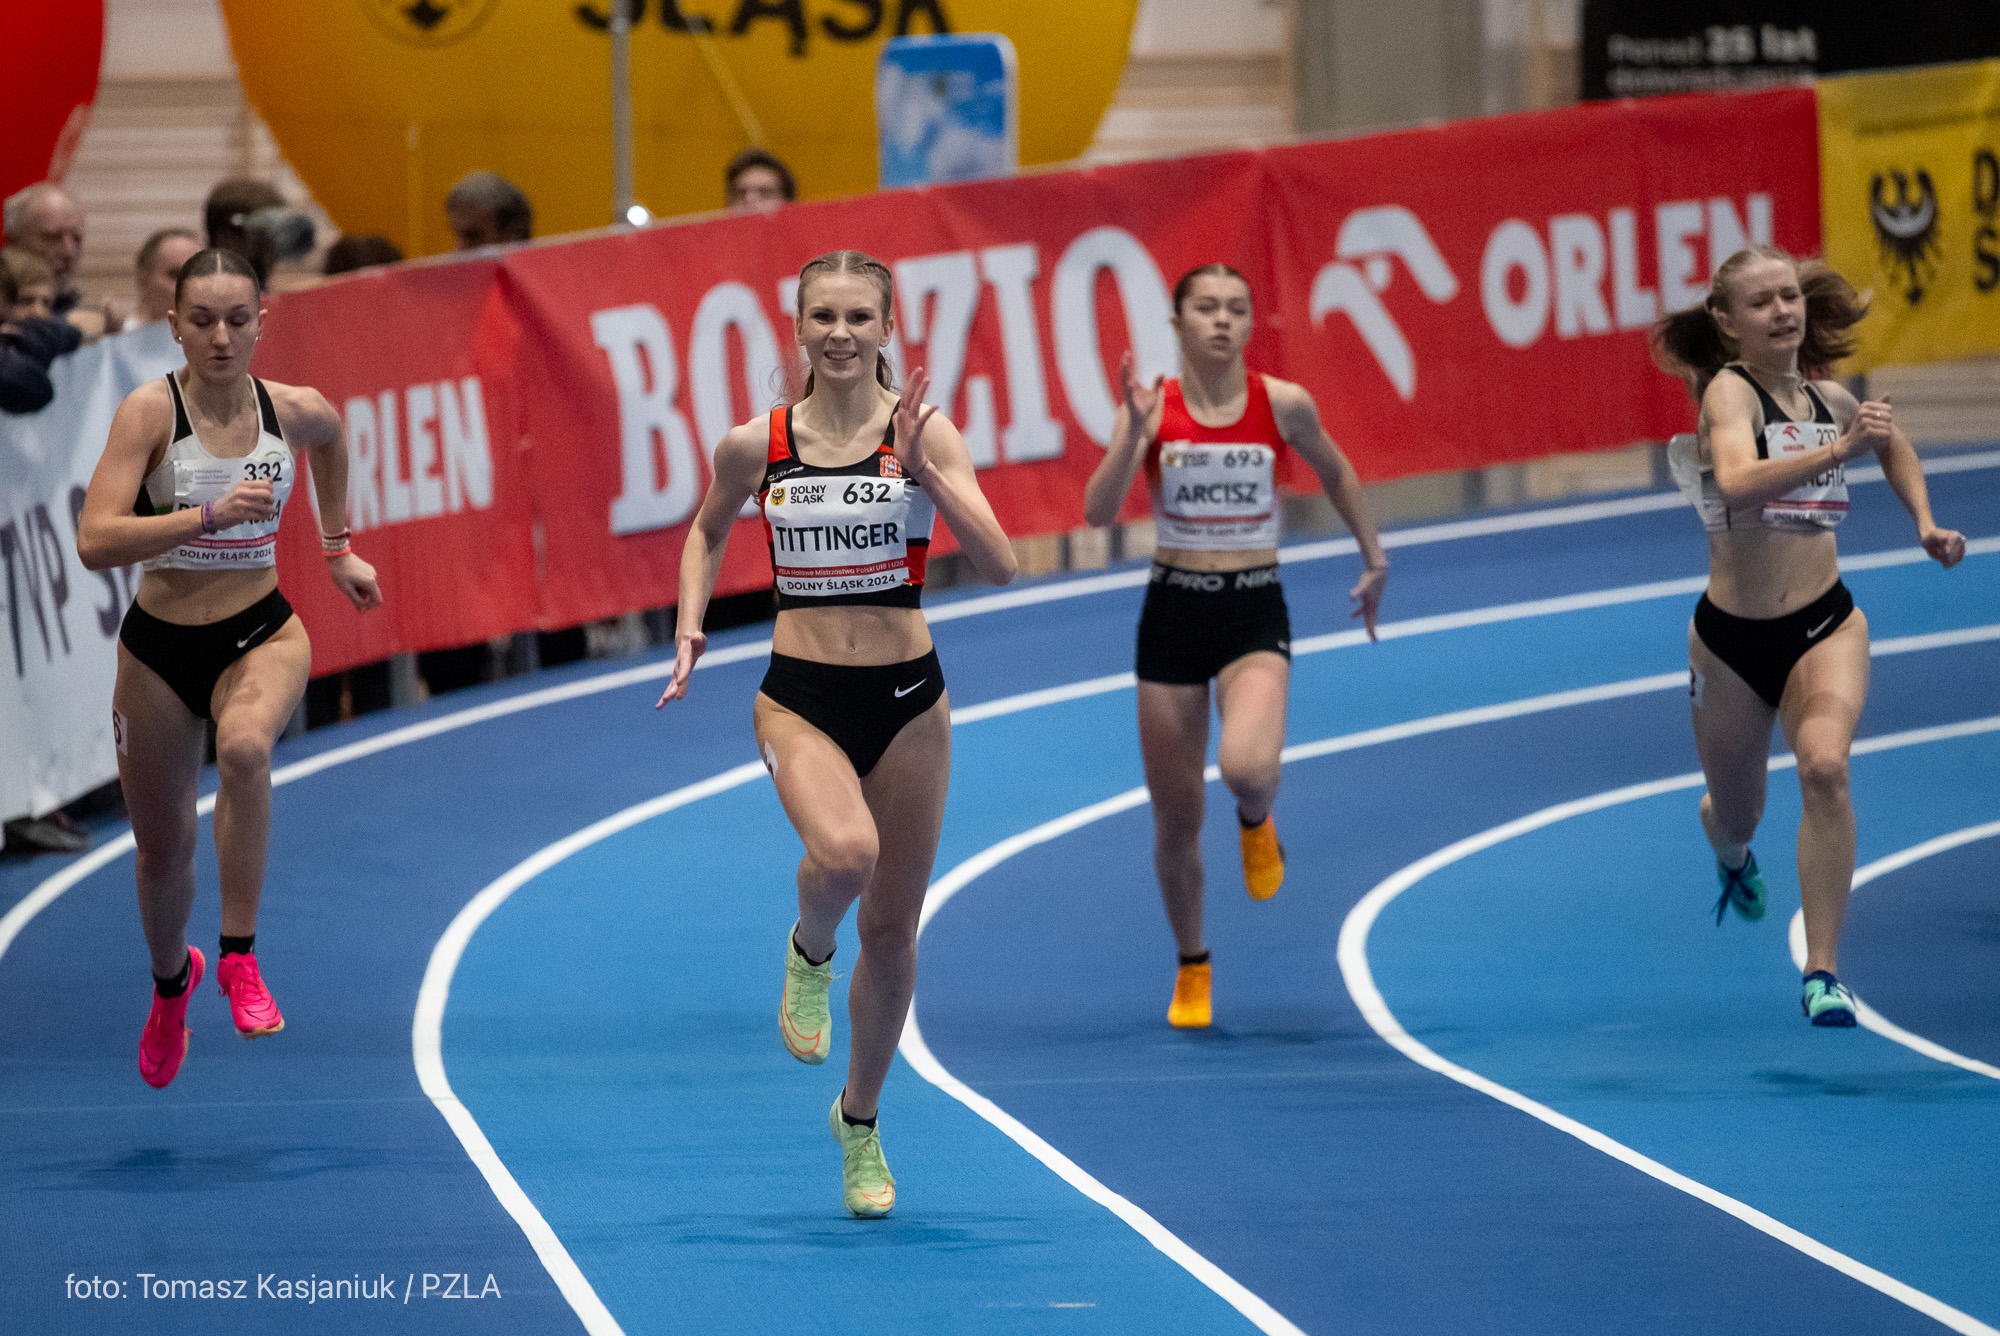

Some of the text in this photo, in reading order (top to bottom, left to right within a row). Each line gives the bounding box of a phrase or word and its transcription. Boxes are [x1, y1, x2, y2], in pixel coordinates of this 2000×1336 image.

[1480, 192, 1774, 349] ORLEN
[590, 226, 1183, 536] BOZIO
[304, 375, 494, 534] RLEN
[1223, 450, 1264, 468] 693
[244, 462, 282, 482] 332
[790, 482, 892, 505] DOLNY 632
[790, 494, 825, 505] ŚLĄSK
[1175, 482, 1259, 504] ARCISZ
[775, 521, 900, 552] TITTINGER
[179, 547, 272, 562] DOLNY ŚLĄSK 2024
[791, 568, 814, 576] Halowe
[815, 567, 855, 576] Mistrzostwa
[855, 566, 876, 575] Polski
[876, 563, 887, 571] U18
[891, 560, 905, 568] U20
[787, 574, 896, 592] DOLNY ŚLĄSK 2024
[1166, 570, 1226, 592] PRO
